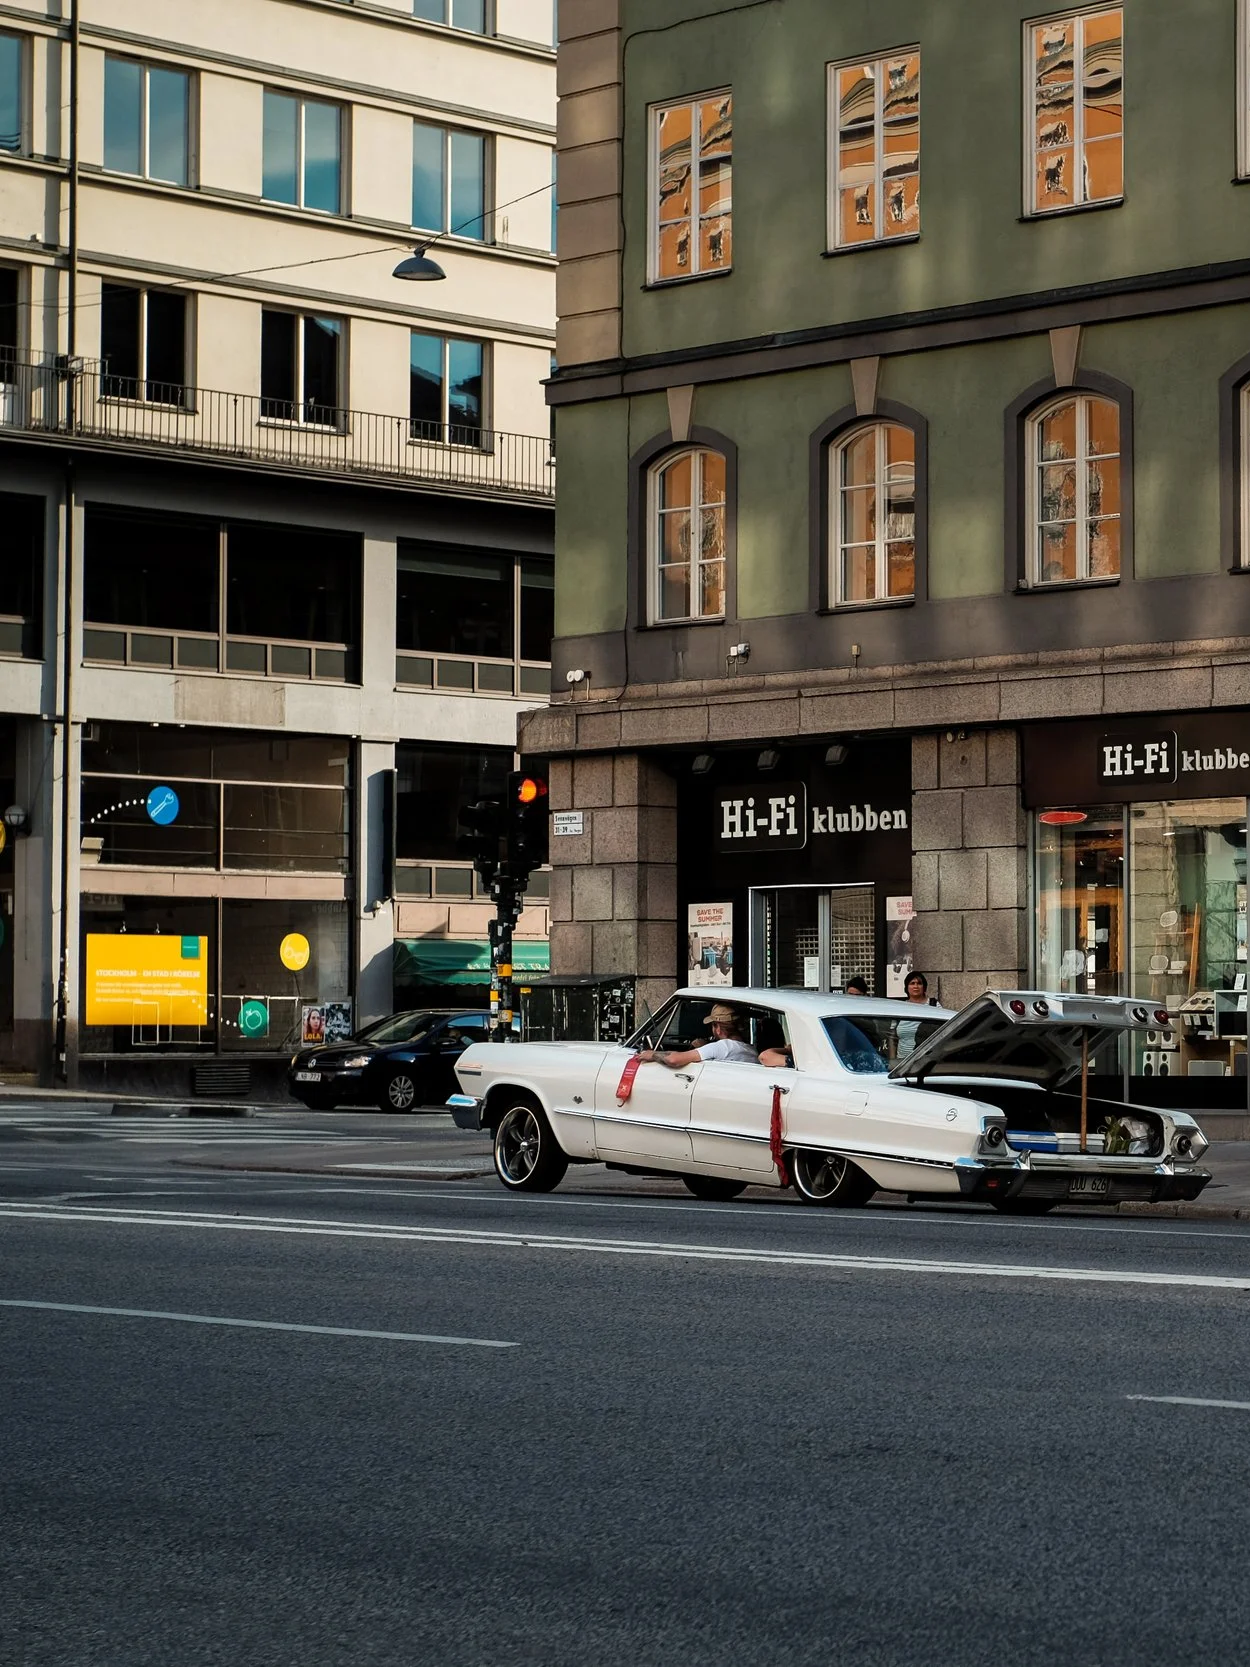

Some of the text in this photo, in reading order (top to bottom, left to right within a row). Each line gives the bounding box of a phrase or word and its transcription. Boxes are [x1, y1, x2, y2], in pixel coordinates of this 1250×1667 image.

[1103, 741, 1170, 777] Hi-Fi
[721, 795, 908, 838] Hi-Fi klubben
[696, 907, 724, 916] SAVE THE
[1091, 1176, 1106, 1191] 626
